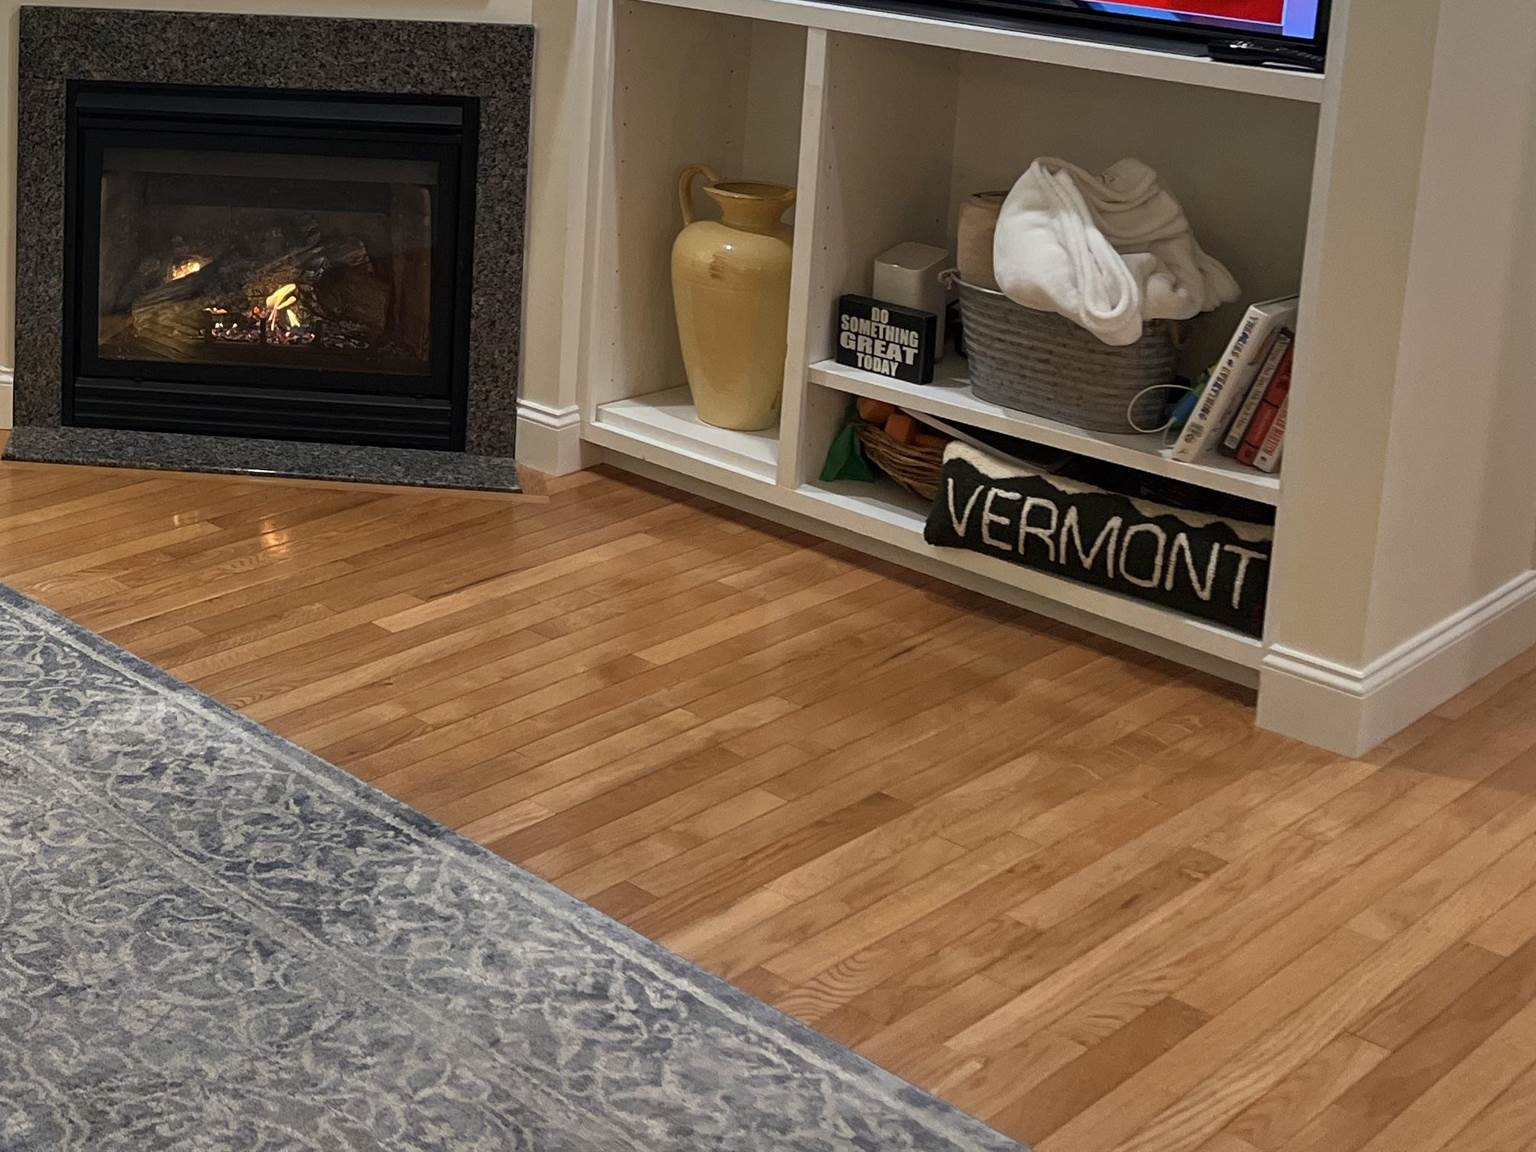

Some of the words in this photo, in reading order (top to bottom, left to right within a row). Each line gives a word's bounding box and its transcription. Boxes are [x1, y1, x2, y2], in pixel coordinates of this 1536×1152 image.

[840, 313, 919, 348] SOMETHING
[871, 306, 889, 324] DO
[839, 331, 919, 366] GREAT
[856, 352, 899, 377] TODAY
[946, 476, 1267, 610] VERMONT
